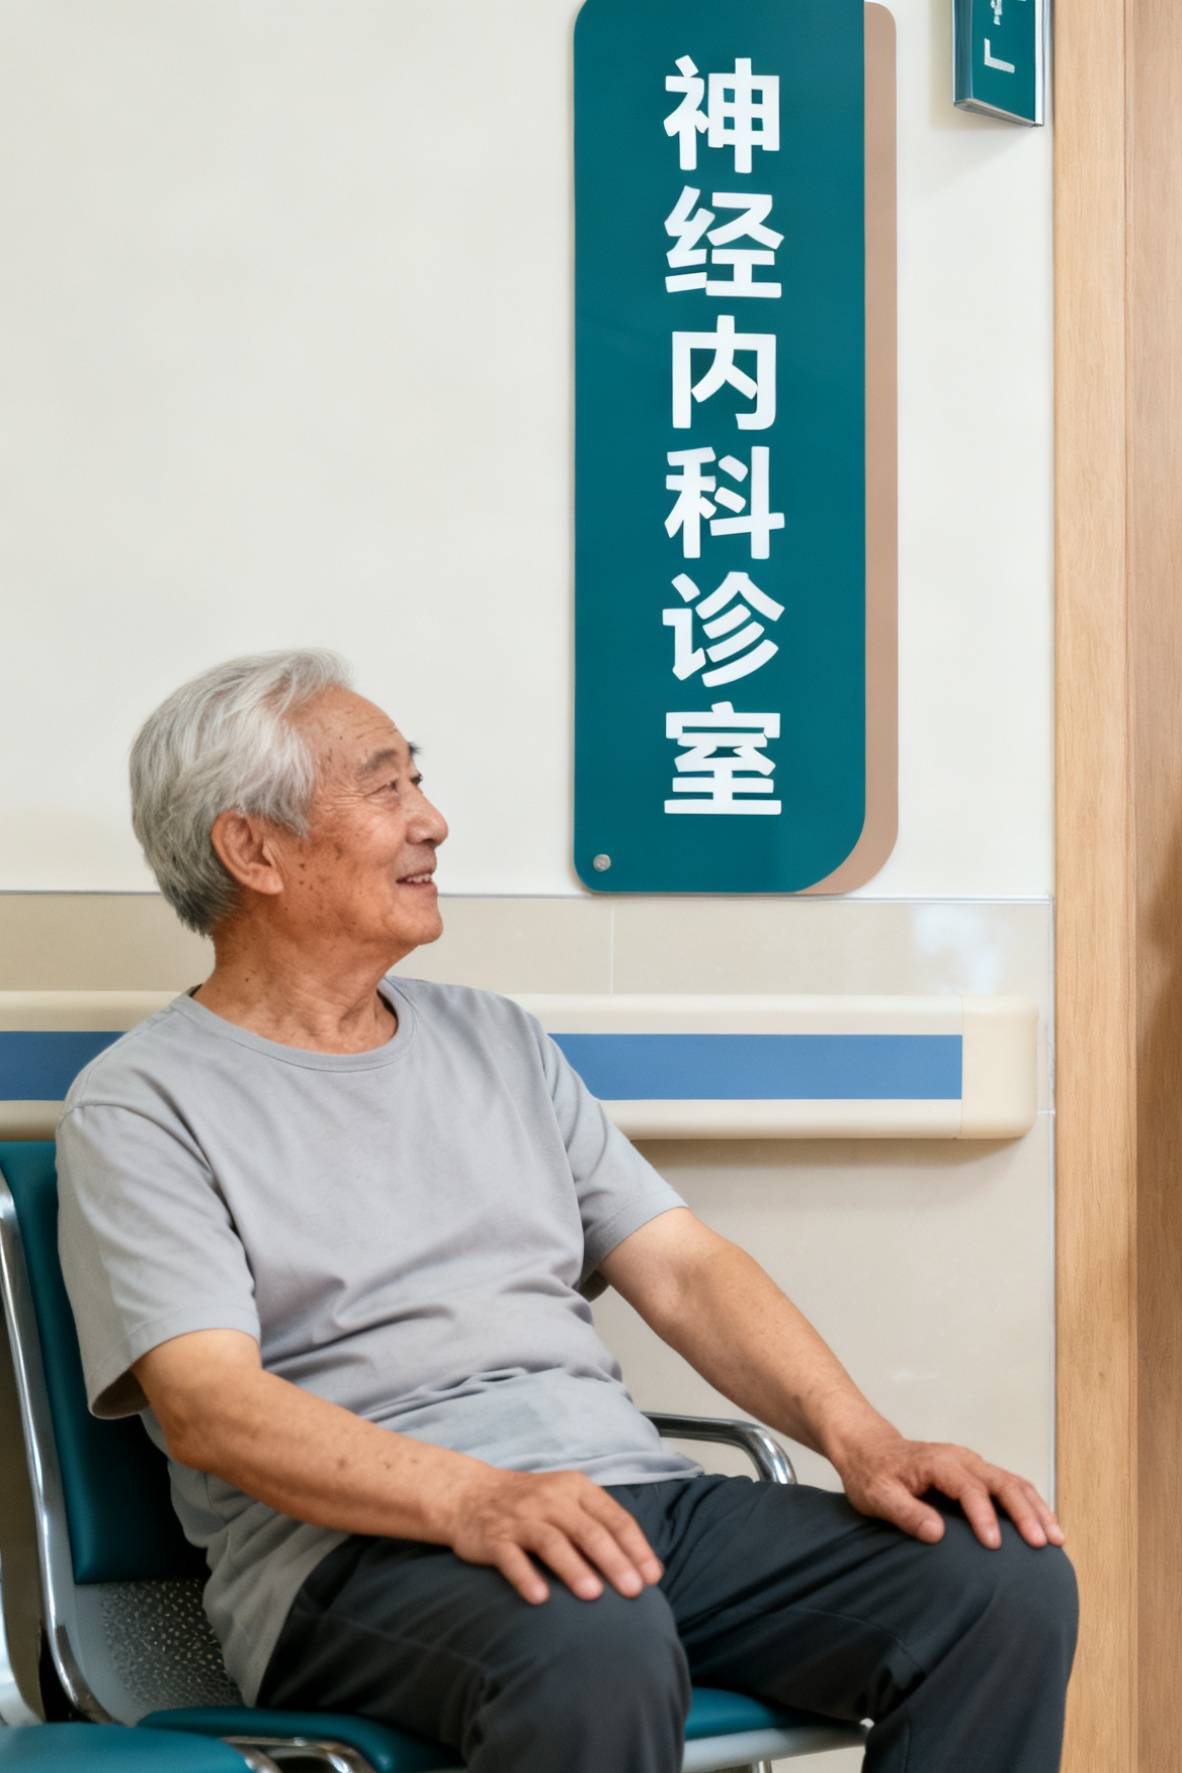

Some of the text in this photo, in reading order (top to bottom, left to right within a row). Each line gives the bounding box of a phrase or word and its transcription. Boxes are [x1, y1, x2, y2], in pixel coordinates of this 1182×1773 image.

[662, 55, 785, 815] 神经内科诊室
